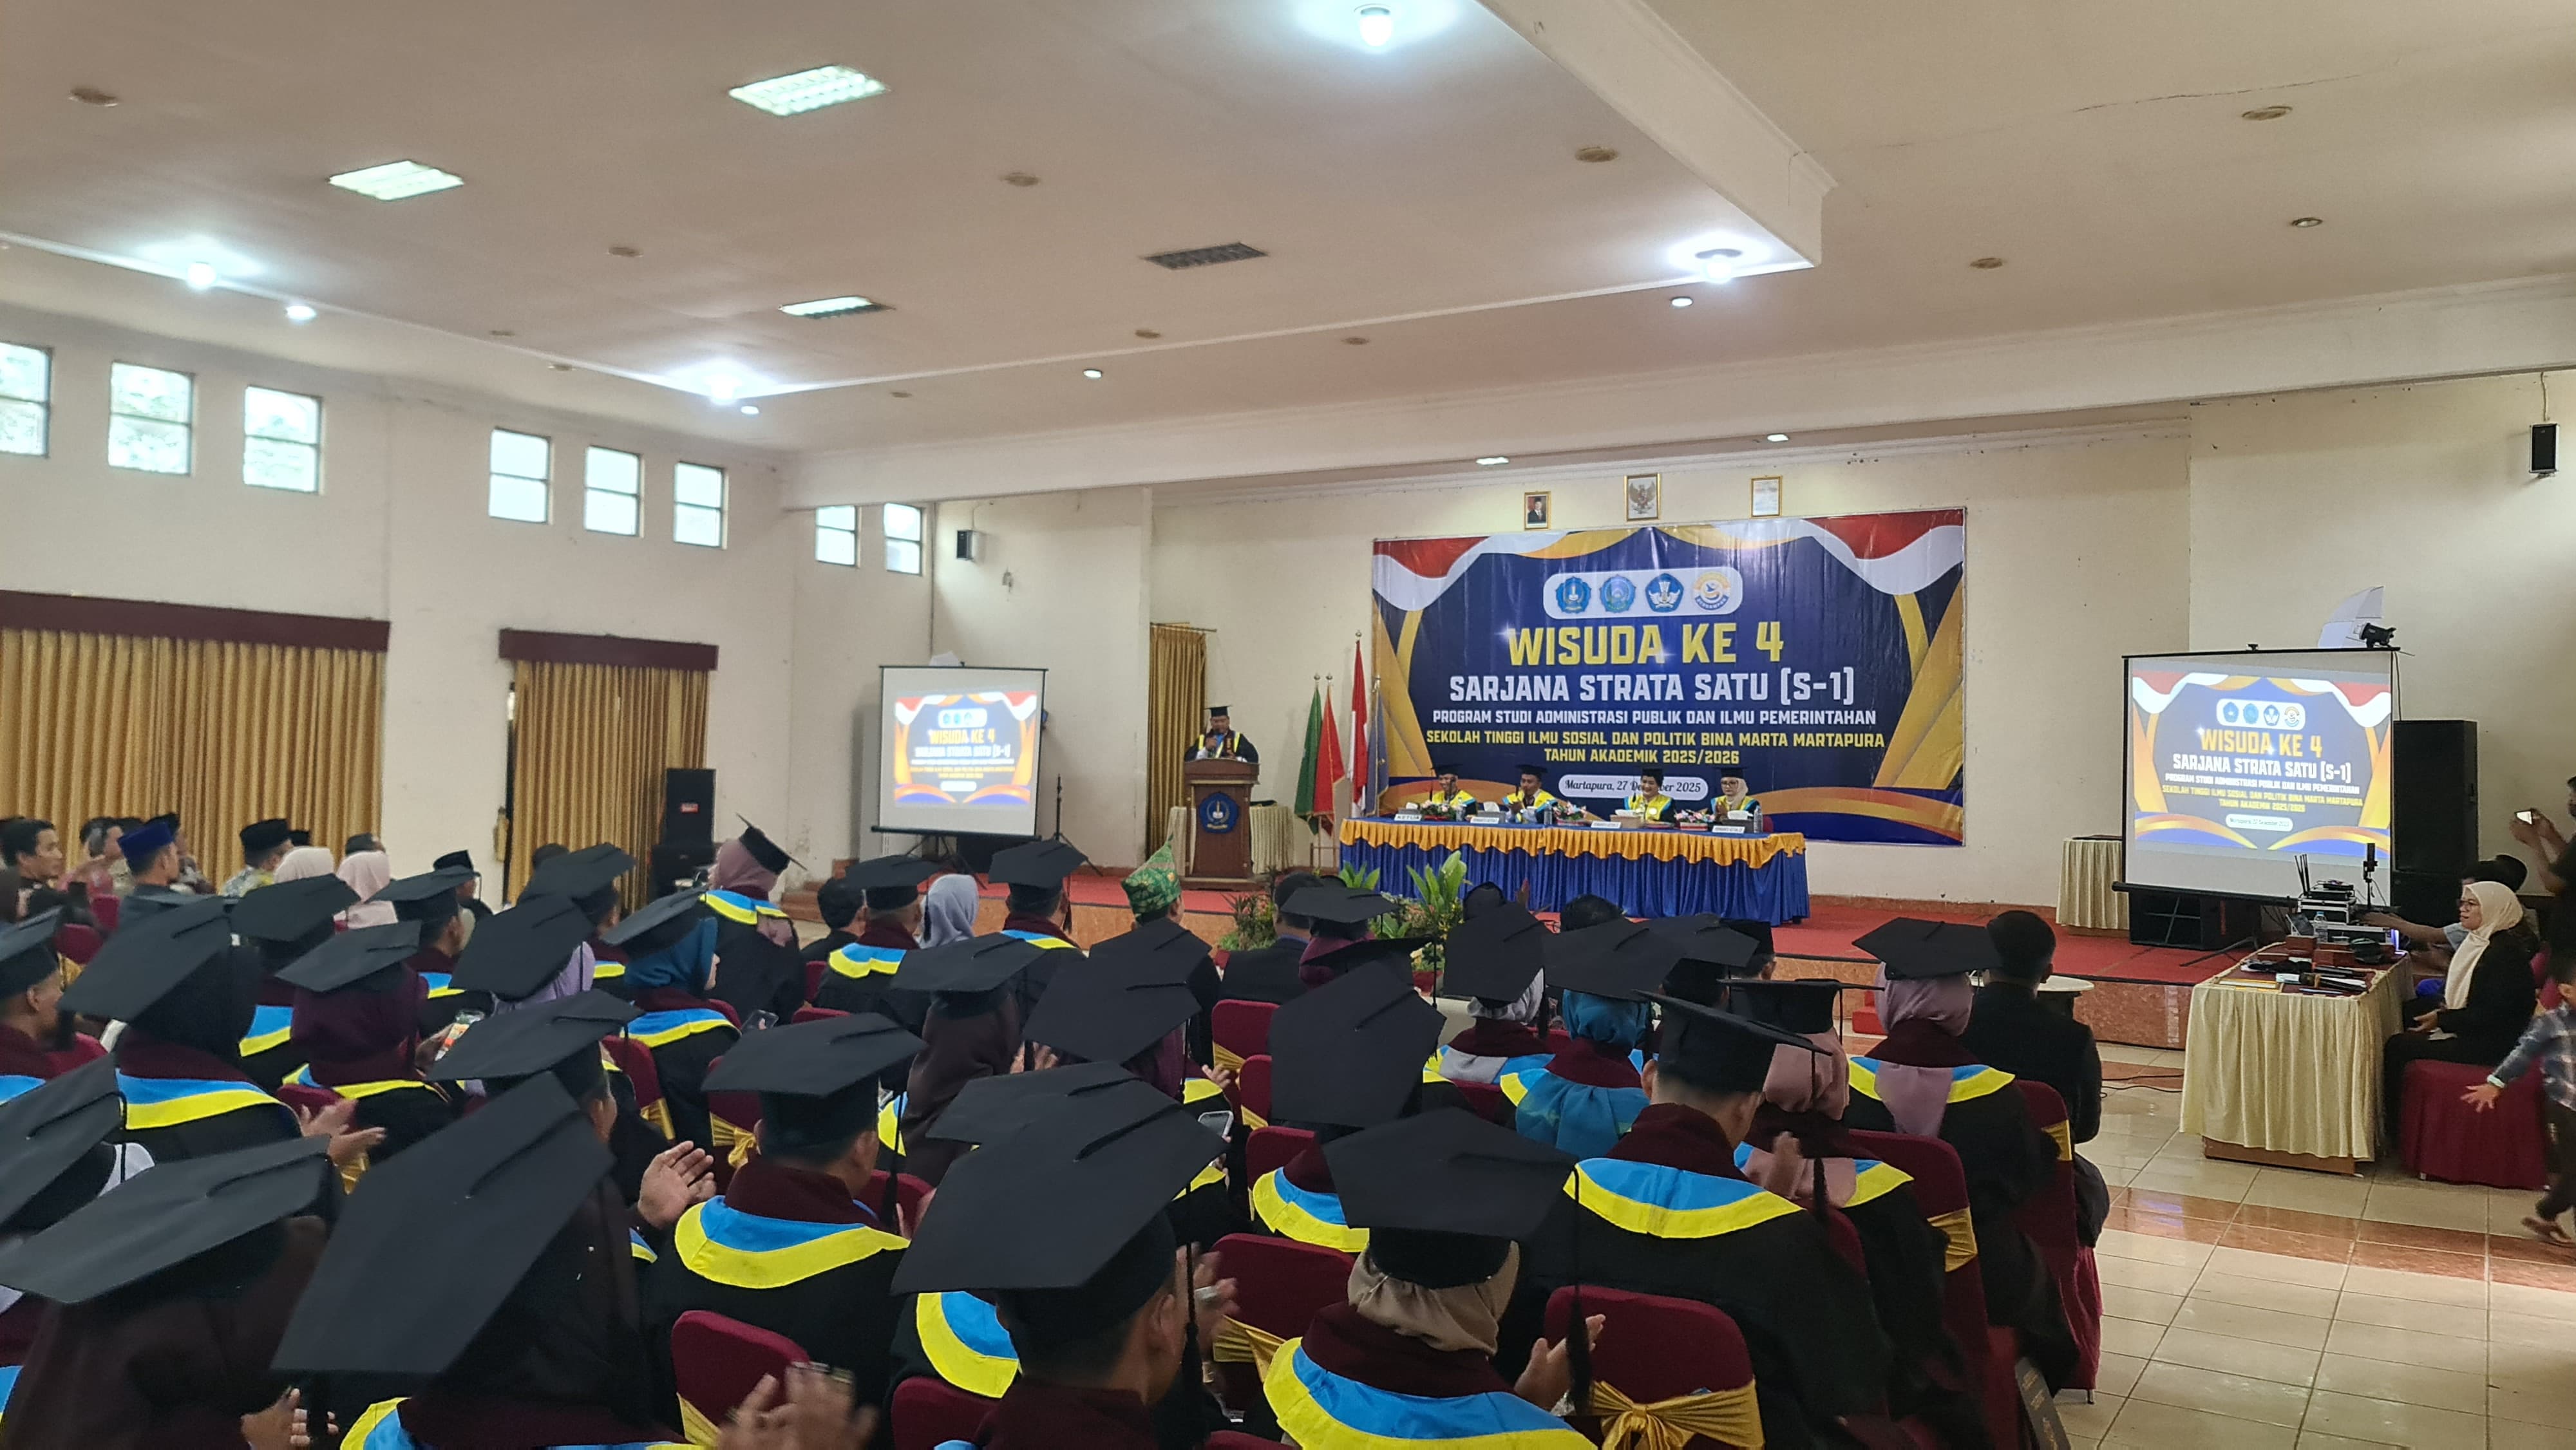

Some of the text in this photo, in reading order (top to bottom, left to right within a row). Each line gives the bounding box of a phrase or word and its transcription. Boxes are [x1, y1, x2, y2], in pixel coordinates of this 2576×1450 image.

[1508, 621, 1784, 666] WISUDA KE 4
[1450, 675, 1569, 702] SARJANA
[1580, 673, 1684, 701] STRATA
[1695, 672, 1768, 701] SATU
[1433, 710, 1876, 724] PROGRAM STUDI ADMINISTRASI PUBLIK DAN ILMU PEMERINTAHAN
[971, 728, 985, 744] KE
[1426, 730, 1885, 748] SEKOLAH TINGGI ILMU SOSIAL DAN POLITIK BINA MARTA MARTAPURA
[2200, 728, 2322, 758] WISUDA KE 4
[1544, 748, 1739, 765] TAHUN AKADEMIK 2025/2026
[2173, 753, 2231, 773] SARJANA
[2234, 758, 2282, 777] STRATA
[2285, 761, 2317, 778] SATU
[1565, 780, 1615, 793] Martapura,
[1616, 780, 1628, 791] 27
[1676, 782, 1701, 793] 2025
